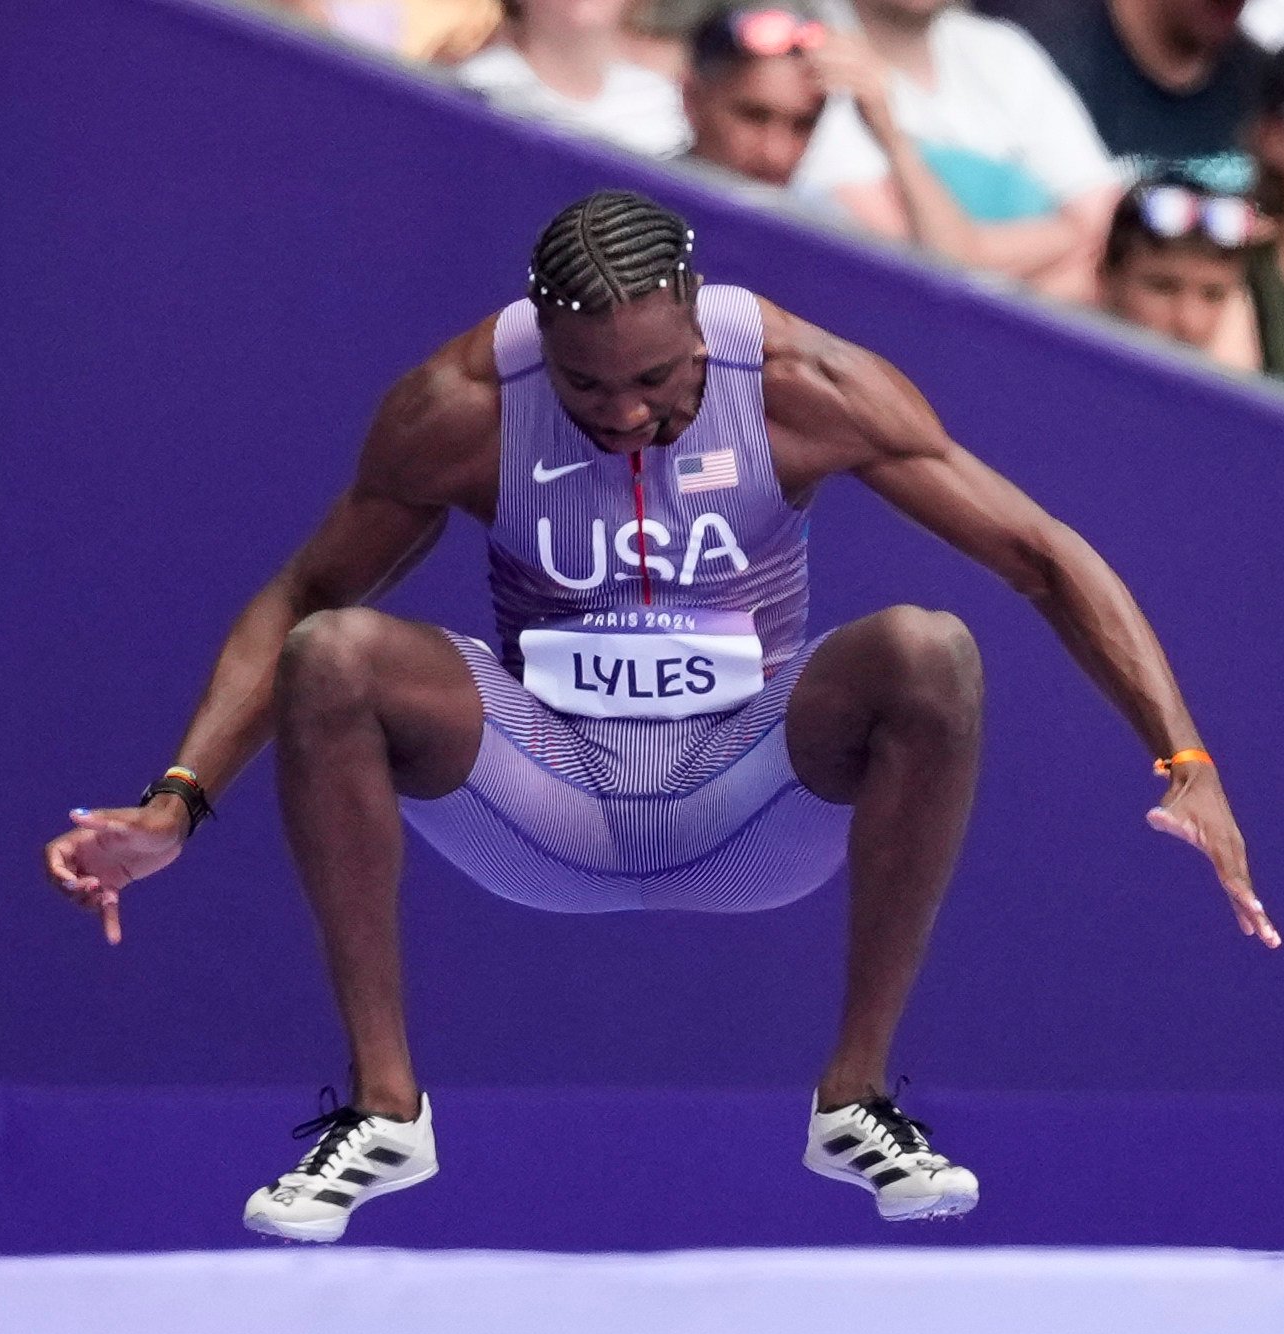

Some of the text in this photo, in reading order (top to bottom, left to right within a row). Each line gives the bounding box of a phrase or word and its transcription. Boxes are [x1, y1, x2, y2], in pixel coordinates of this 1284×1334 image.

[538, 512, 749, 590] USA
[583, 613, 638, 628] PARIS
[573, 652, 716, 698] LYLES
